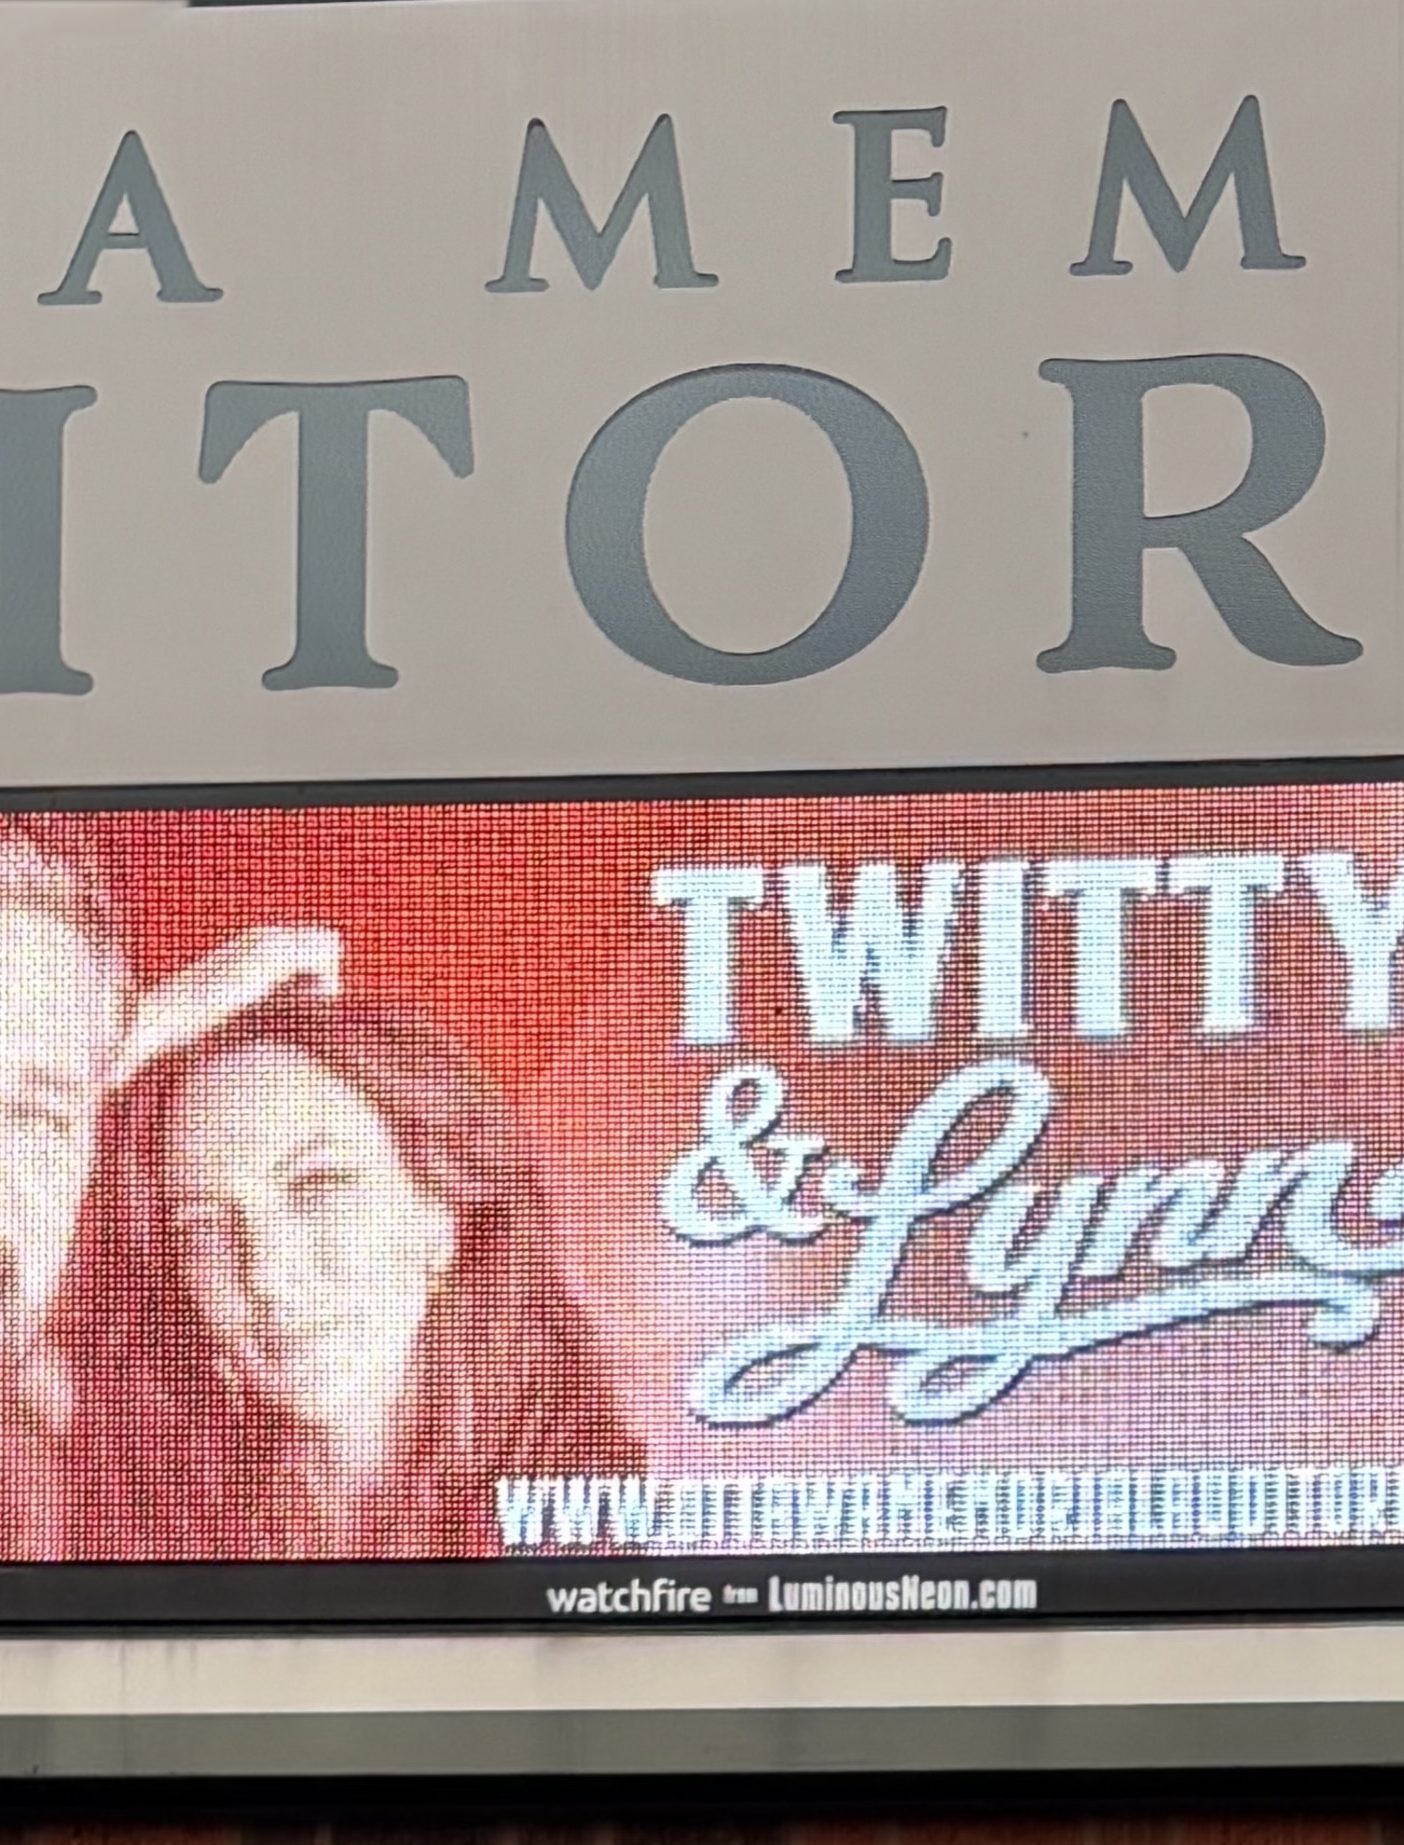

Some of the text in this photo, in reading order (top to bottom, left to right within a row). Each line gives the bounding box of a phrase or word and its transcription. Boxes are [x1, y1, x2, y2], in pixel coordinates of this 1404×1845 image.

[658, 1060, 829, 1245] &
[546, 1577, 713, 1613] watchfire
[767, 1574, 1039, 1613] LuminousNeon.com
